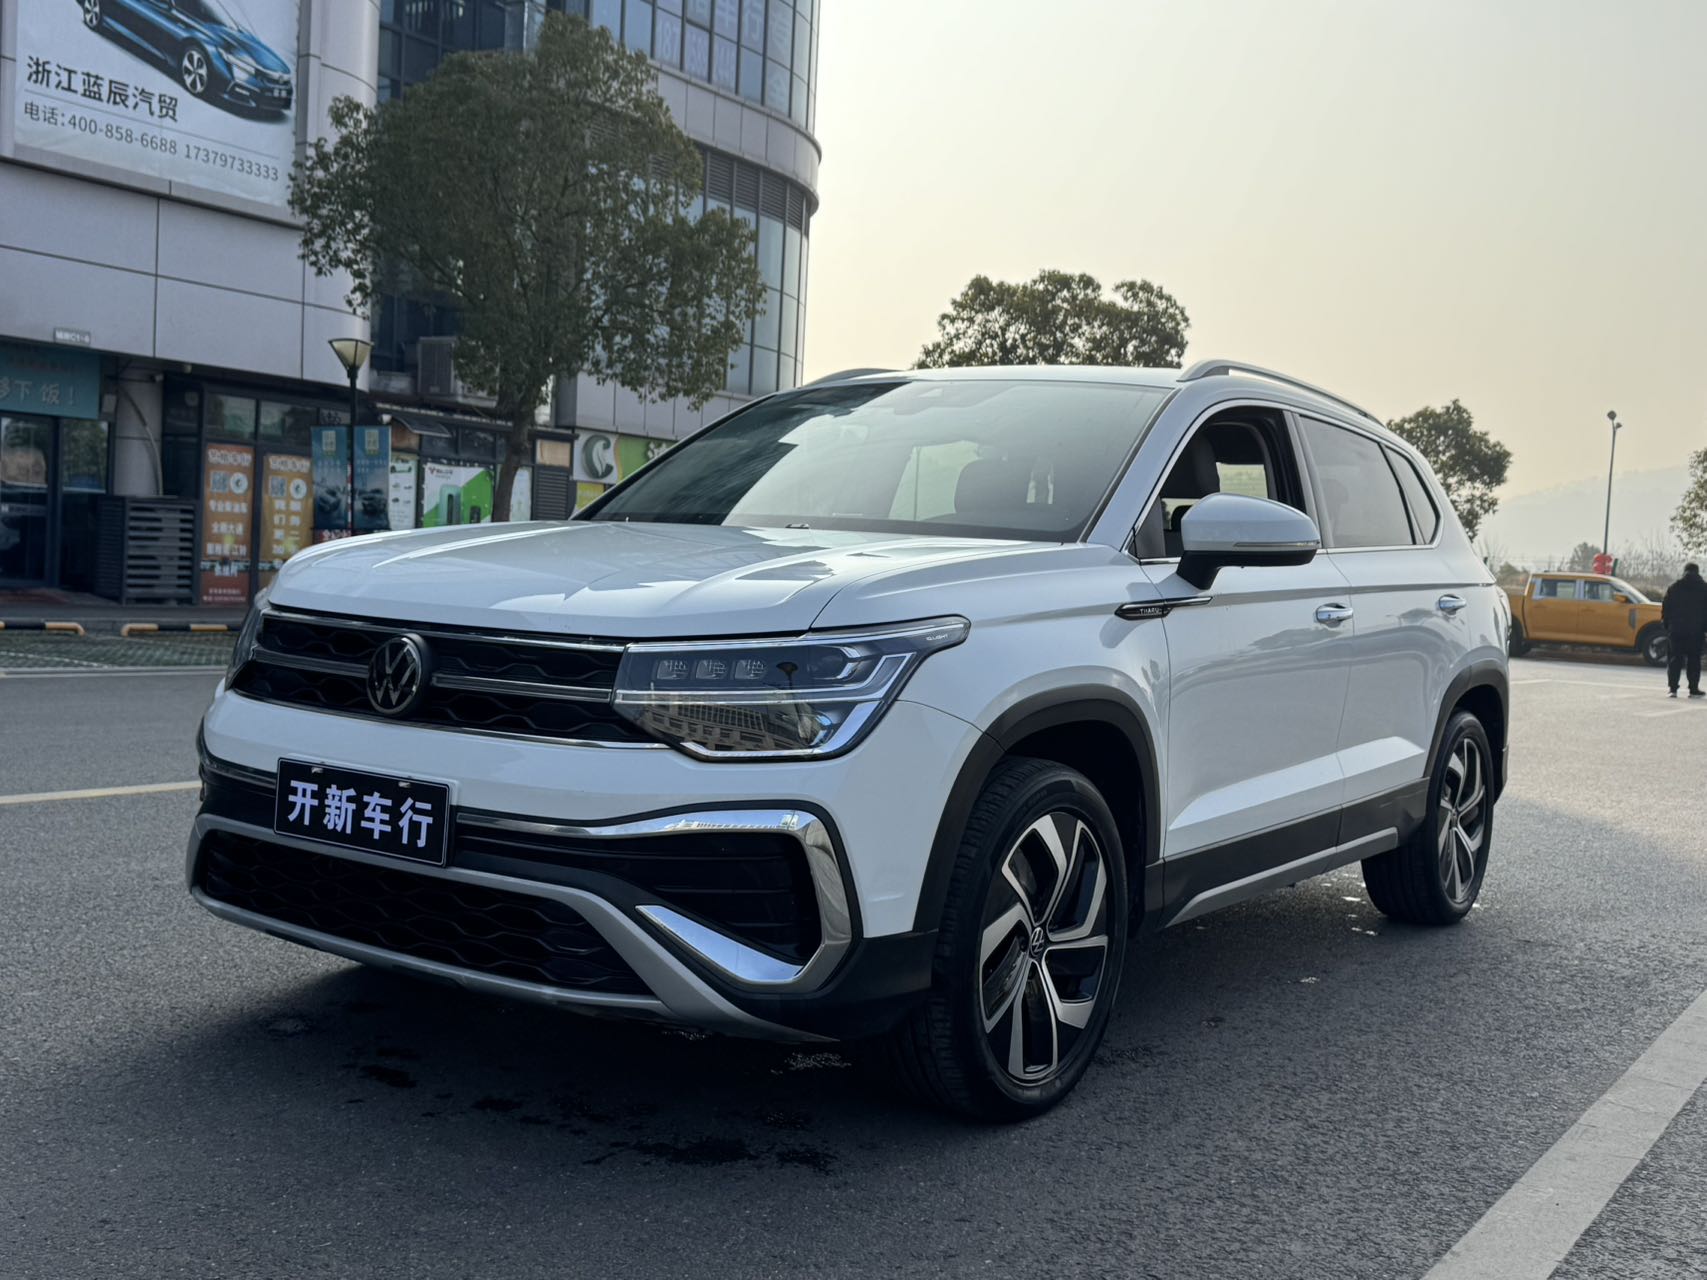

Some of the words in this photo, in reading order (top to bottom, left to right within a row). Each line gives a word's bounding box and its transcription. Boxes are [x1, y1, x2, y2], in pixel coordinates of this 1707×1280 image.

[27, 55, 178, 123] 浙江蓝辰汽贸
[24, 101, 178, 155] 电话:400-858-6688
[184, 144, 279, 181] 17379733333
[287, 779, 434, 848] 开新车行
